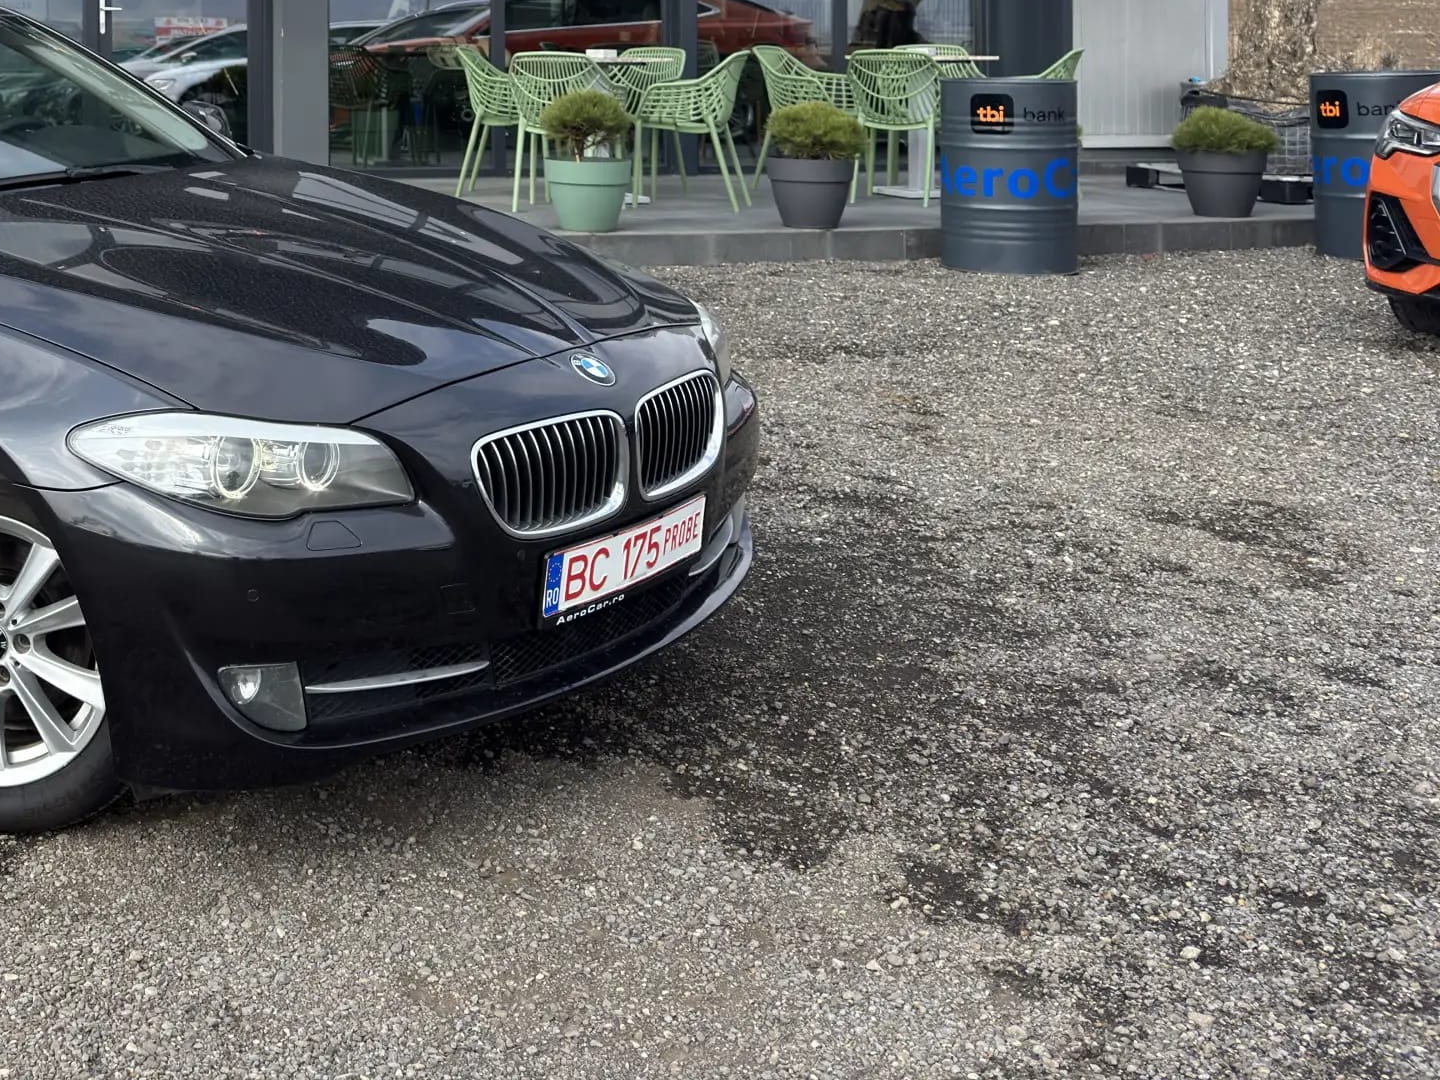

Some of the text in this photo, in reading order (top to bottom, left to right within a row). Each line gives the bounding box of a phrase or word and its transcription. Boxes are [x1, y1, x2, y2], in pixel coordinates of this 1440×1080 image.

[976, 105, 1065, 123] tbi bank
[1320, 100, 1400, 117] tbi ban
[564, 511, 701, 602] BC 175 PROBE
[546, 587, 560, 609] RO
[556, 593, 625, 626] AeroCar.ro
